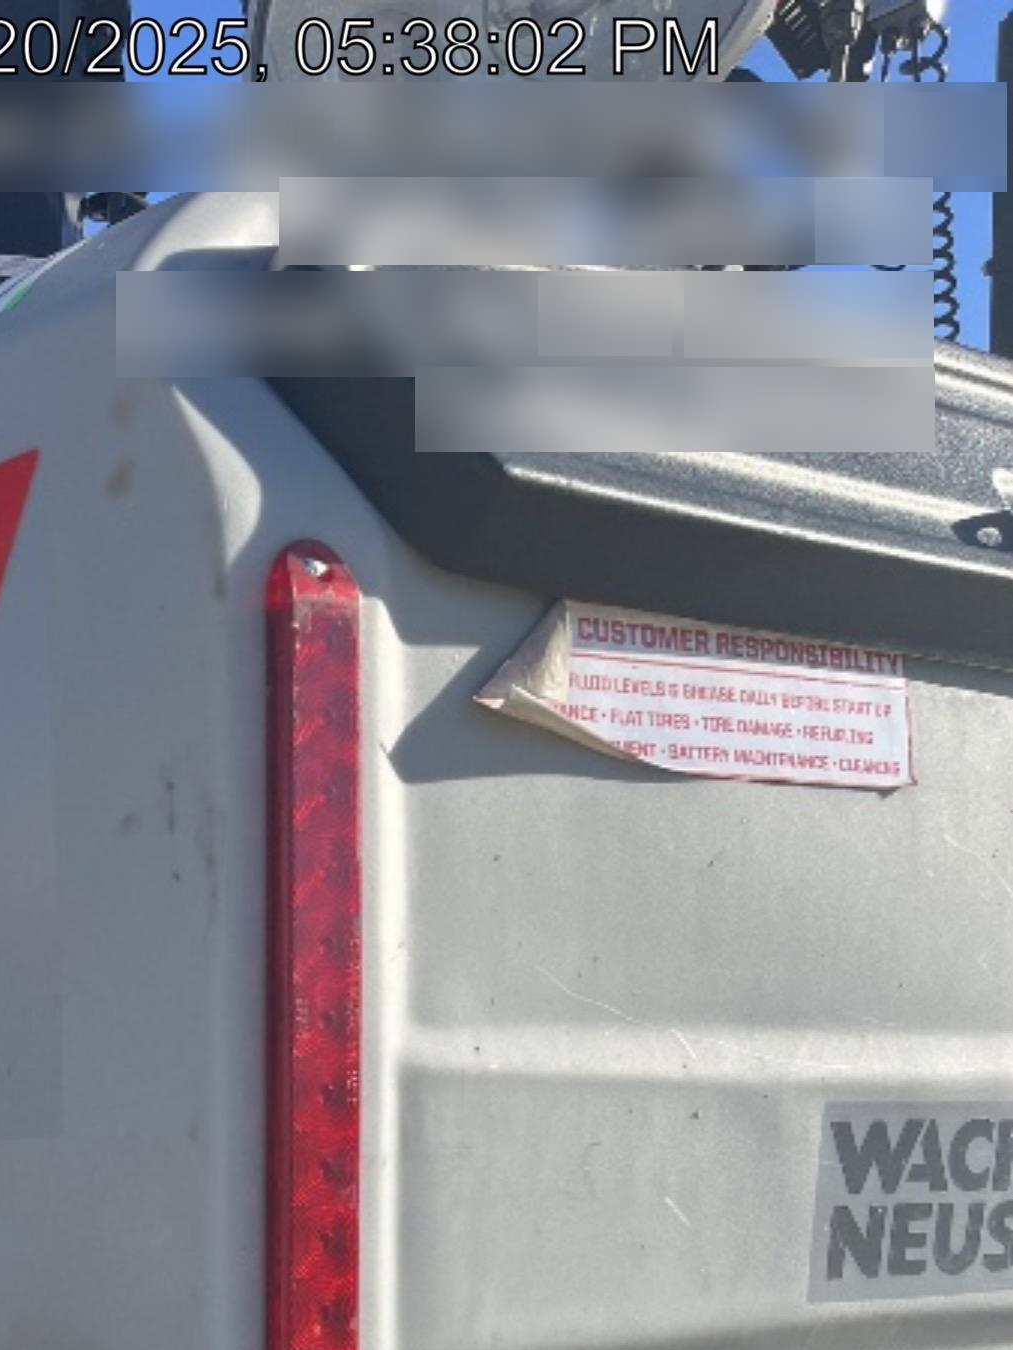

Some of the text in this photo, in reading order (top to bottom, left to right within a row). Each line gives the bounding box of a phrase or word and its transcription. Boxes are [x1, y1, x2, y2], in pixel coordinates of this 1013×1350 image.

[577, 617, 899, 676] CUSTOMER RESPONSIBILITY
[569, 671, 611, 691] FLUID
[614, 677, 666, 697] LEVELS
[740, 688, 778, 706] DAILY
[781, 693, 830, 712] BEFORE
[833, 698, 872, 716] START
[875, 702, 892, 718] UP
[610, 707, 646, 727] FLAT
[649, 710, 691, 730] TIRES
[701, 716, 735, 733] TIRE
[738, 719, 793, 739] DAMAGE
[668, 743, 730, 763] BATTERY
[734, 749, 829, 770] MAINTENANCE
[839, 757, 901, 776] CLEANING
